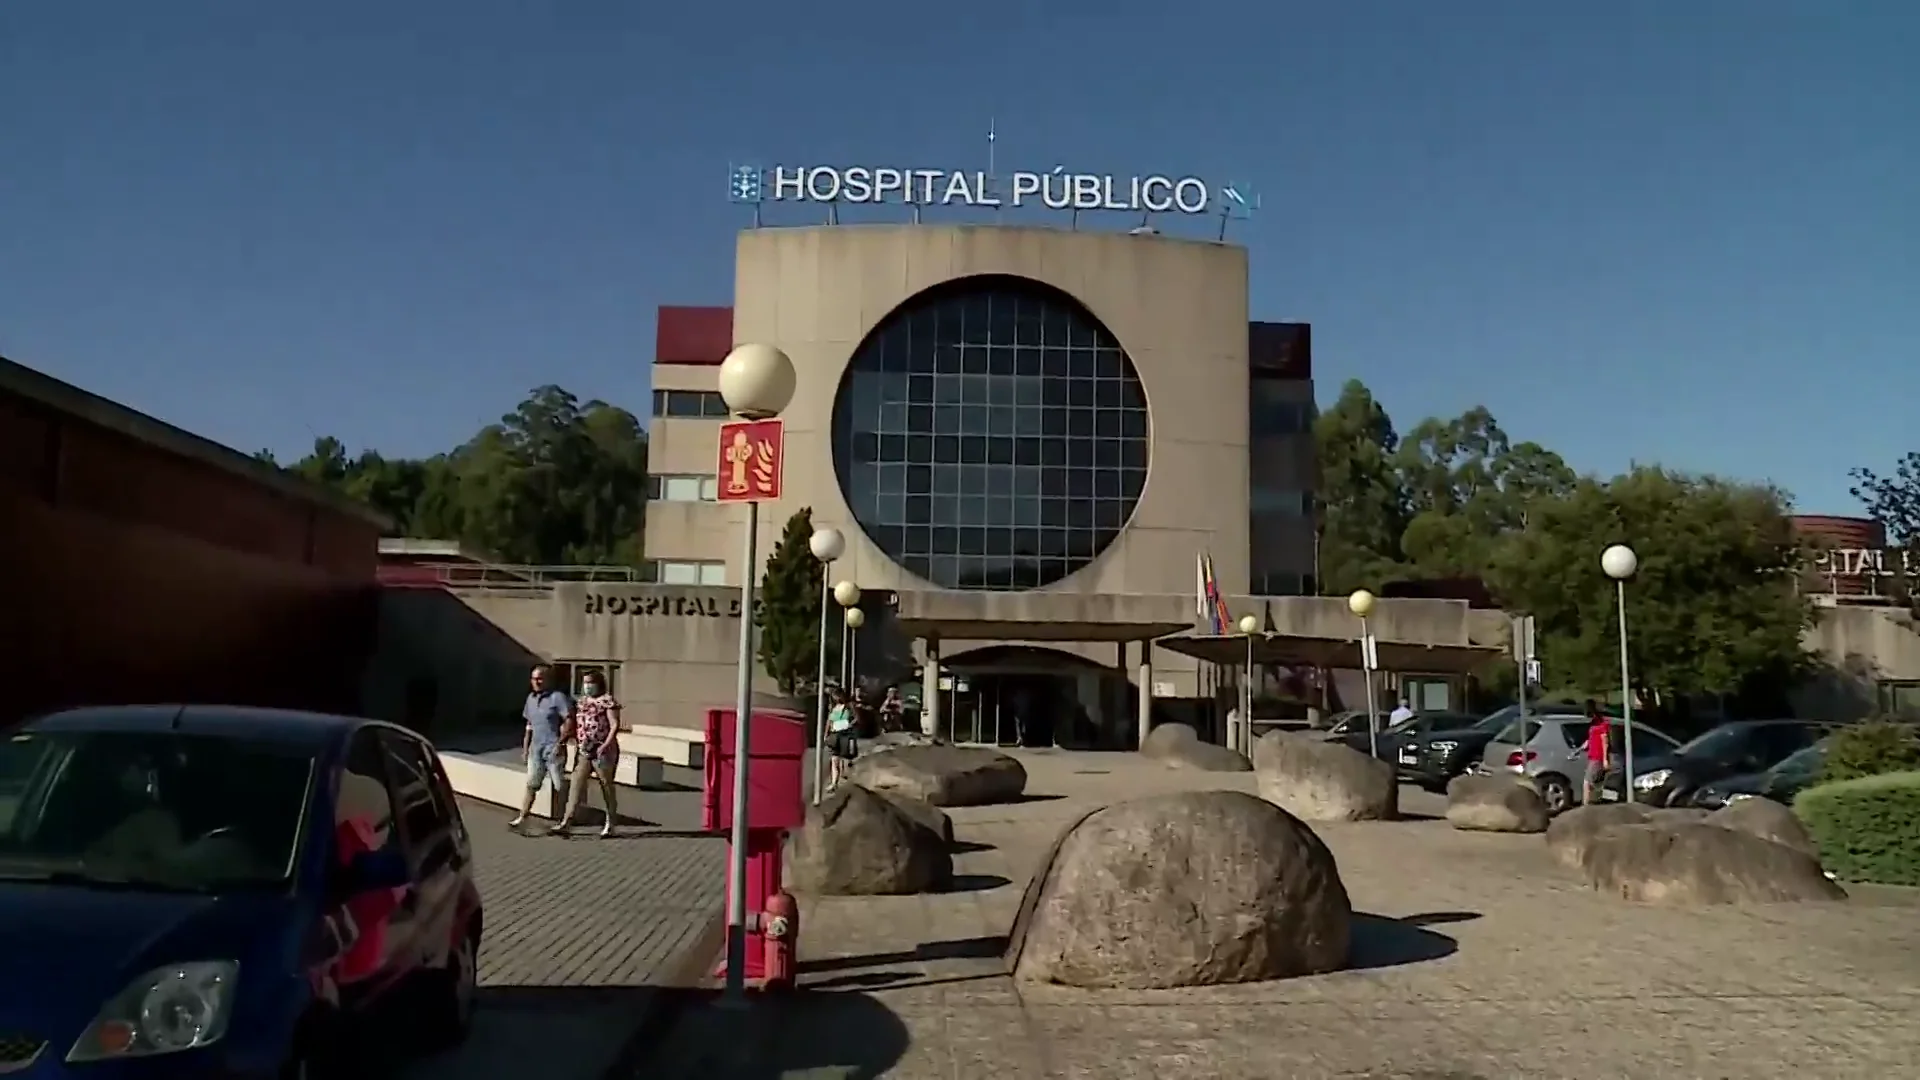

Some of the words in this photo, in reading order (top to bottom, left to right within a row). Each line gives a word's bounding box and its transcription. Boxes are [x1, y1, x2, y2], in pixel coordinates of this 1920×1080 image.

[775, 165, 1001, 204] HOSPITAL
[1012, 165, 1208, 213] PÚBLICO
[584, 593, 720, 617] HOSPITAL
